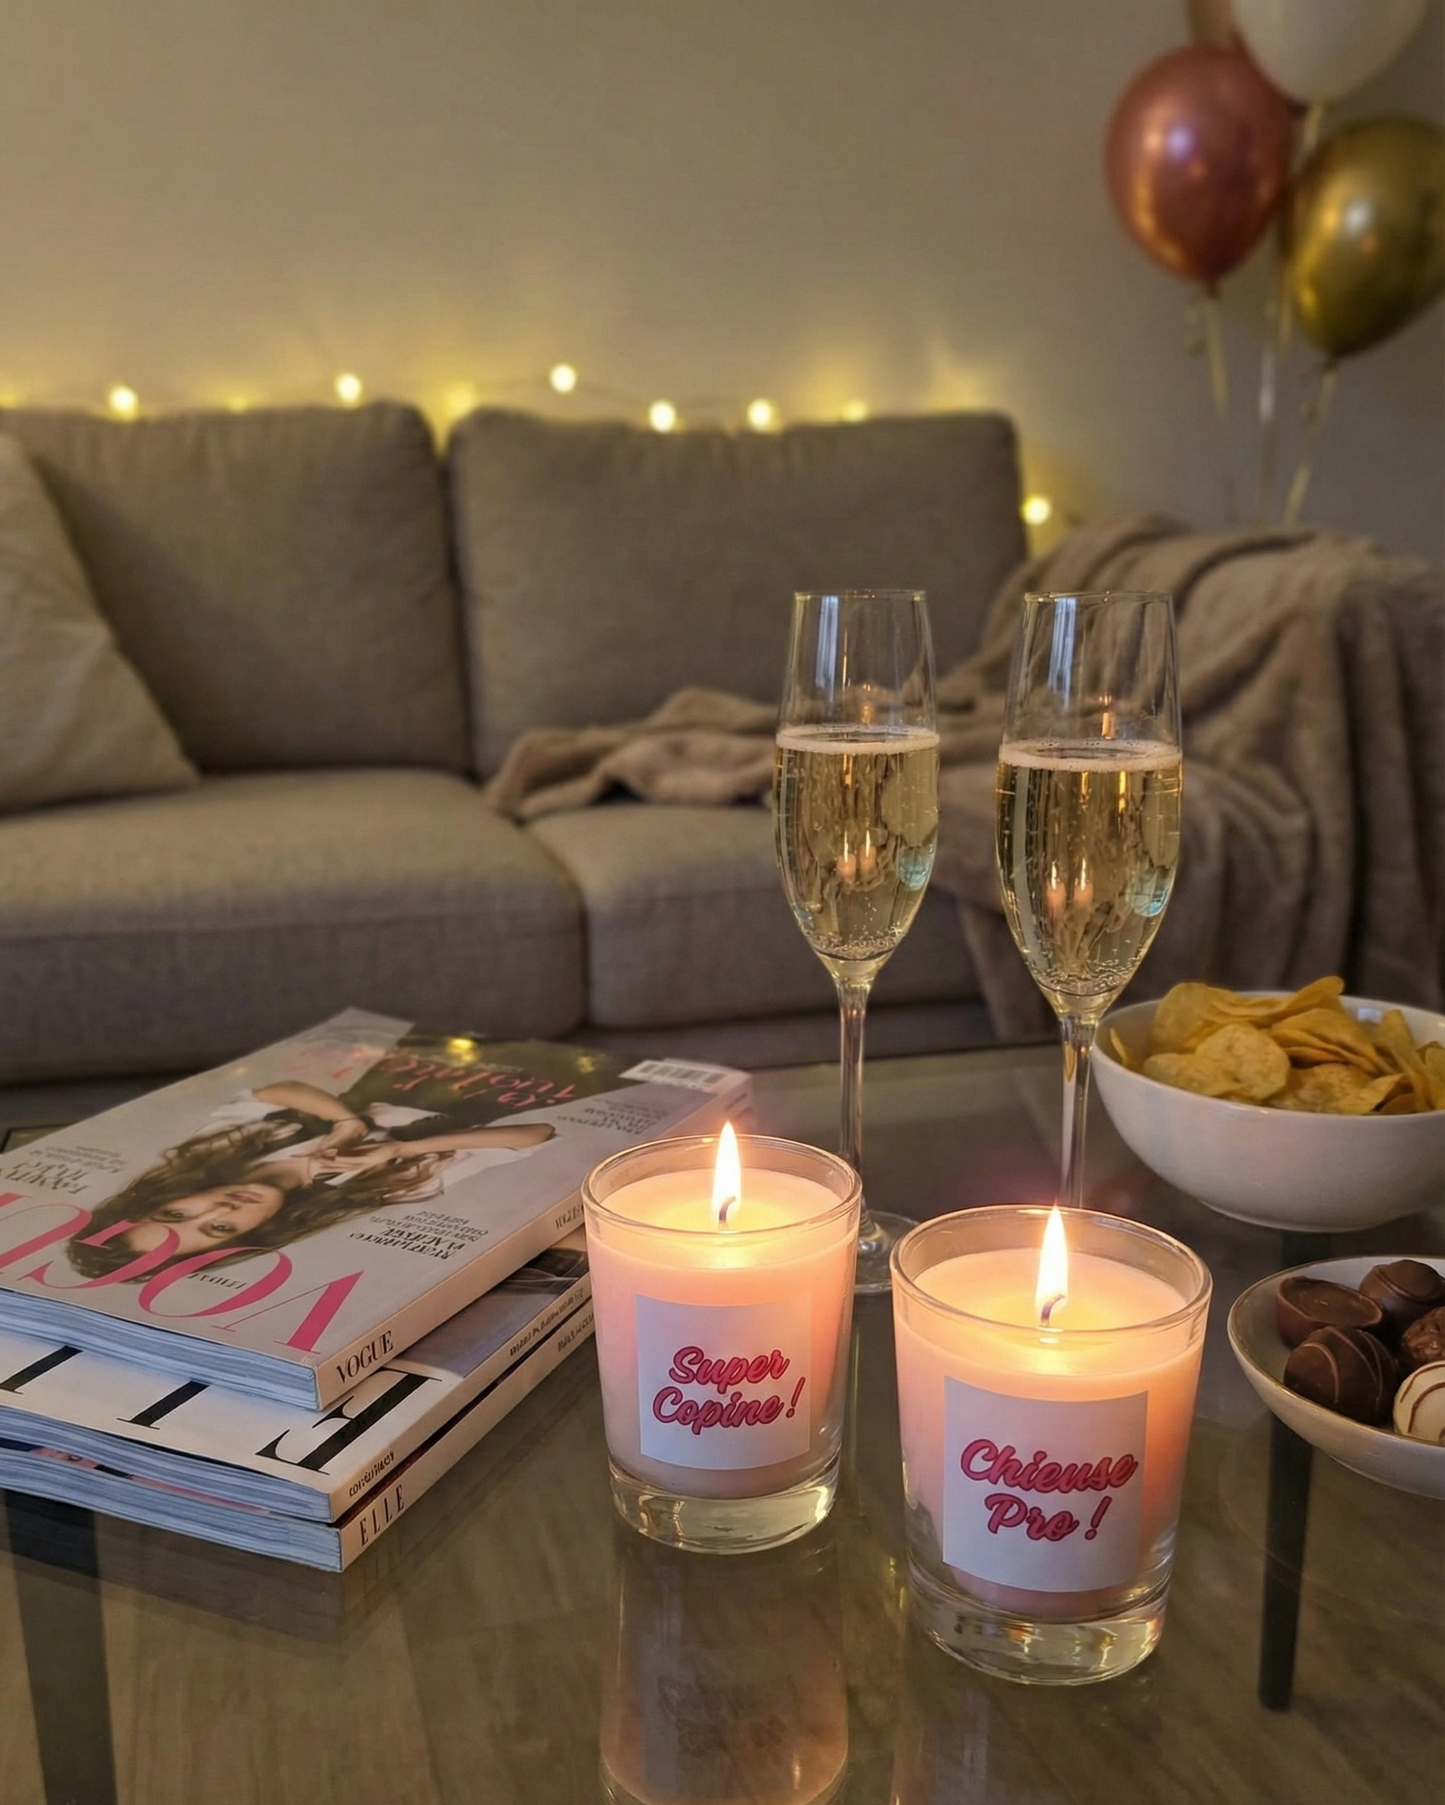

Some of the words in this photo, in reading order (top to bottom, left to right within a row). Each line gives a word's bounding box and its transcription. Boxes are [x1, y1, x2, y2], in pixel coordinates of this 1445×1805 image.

[336, 1329, 394, 1385] VOGUE
[669, 1346, 790, 1394] Super
[961, 1438, 1139, 1494] Chieuse
[358, 1483, 405, 1547] ELLE
